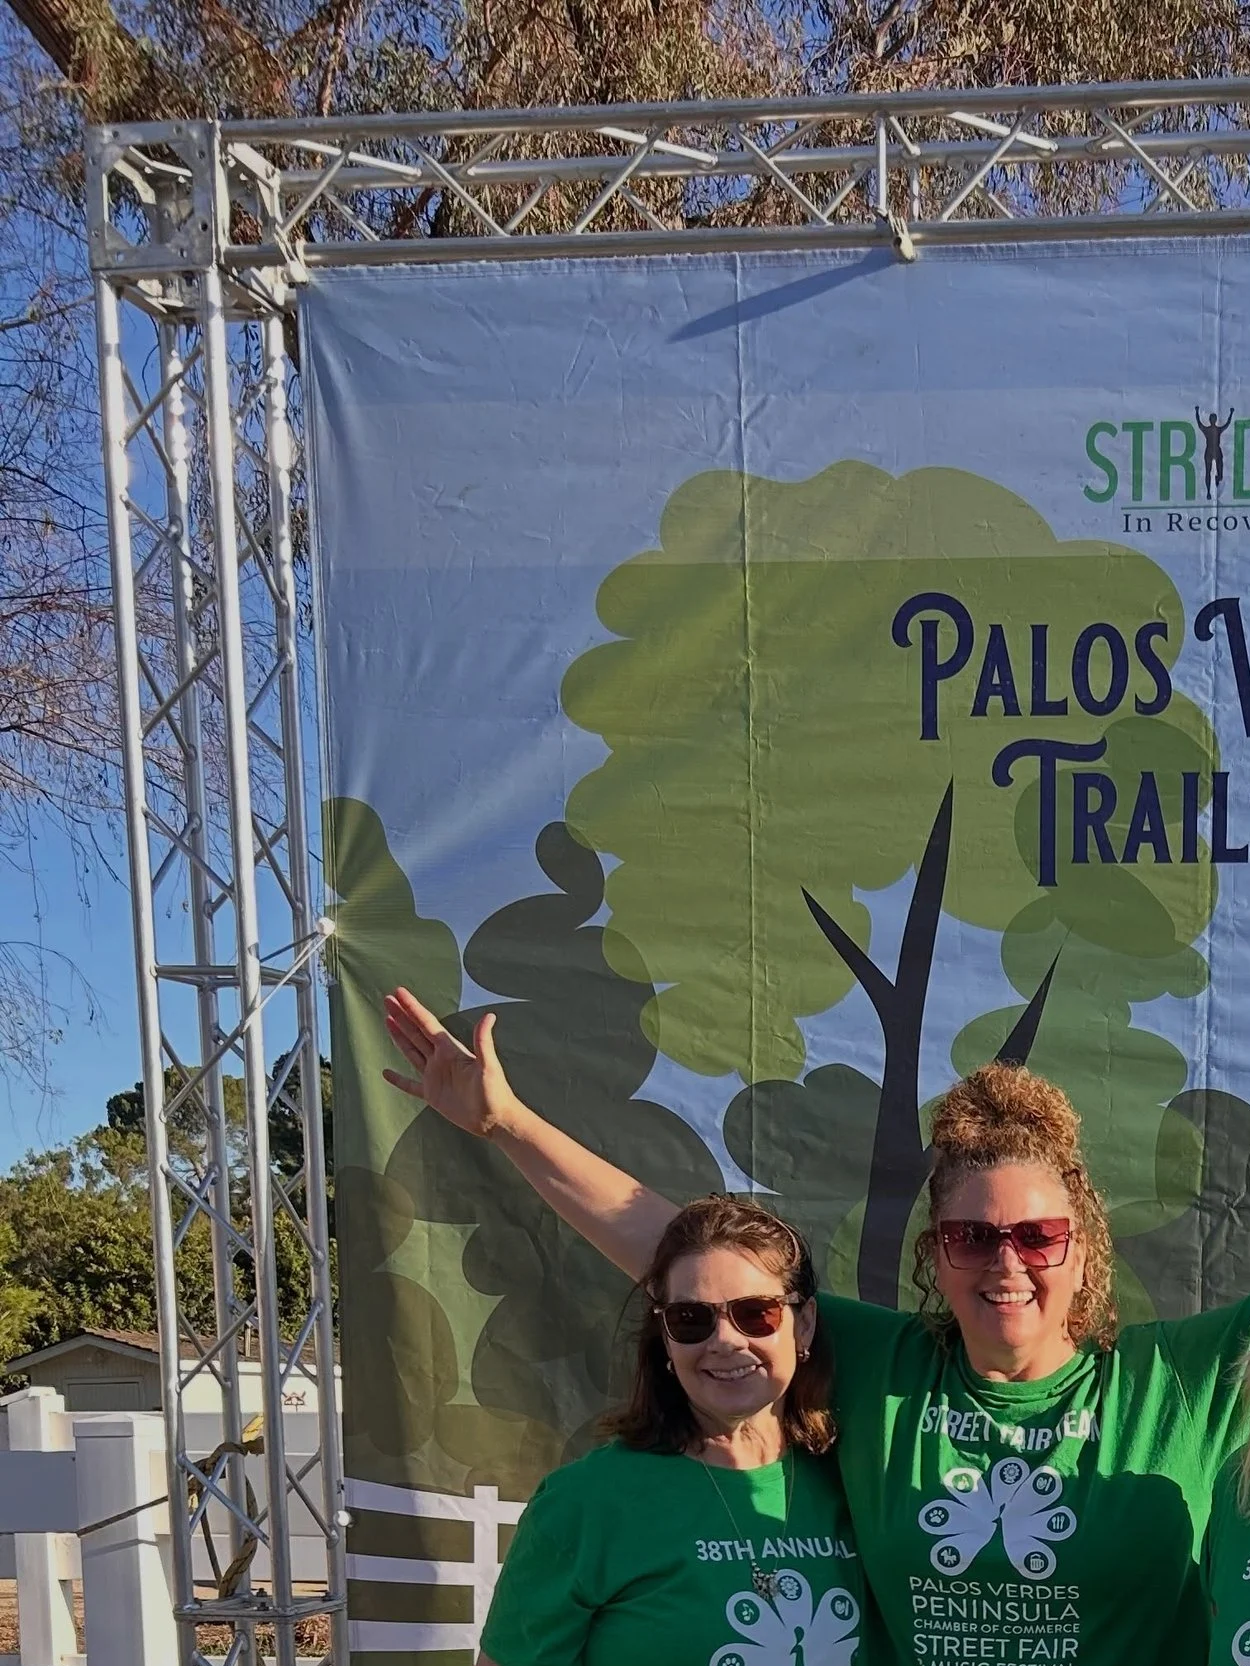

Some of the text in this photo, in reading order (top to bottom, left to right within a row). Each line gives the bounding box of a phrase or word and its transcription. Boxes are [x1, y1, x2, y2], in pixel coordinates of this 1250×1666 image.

[1122, 512, 1152, 533] In
[891, 592, 1173, 740] PALOS
[695, 1536, 857, 1561] 38TH ANNUAL
[909, 1576, 1080, 1600] PALOS VERDES
[912, 1595, 1080, 1622] PENINSULA
[913, 1618, 1081, 1635] CHAMBER OF COMMERCE
[913, 1633, 1079, 1660] STREET FAIR
